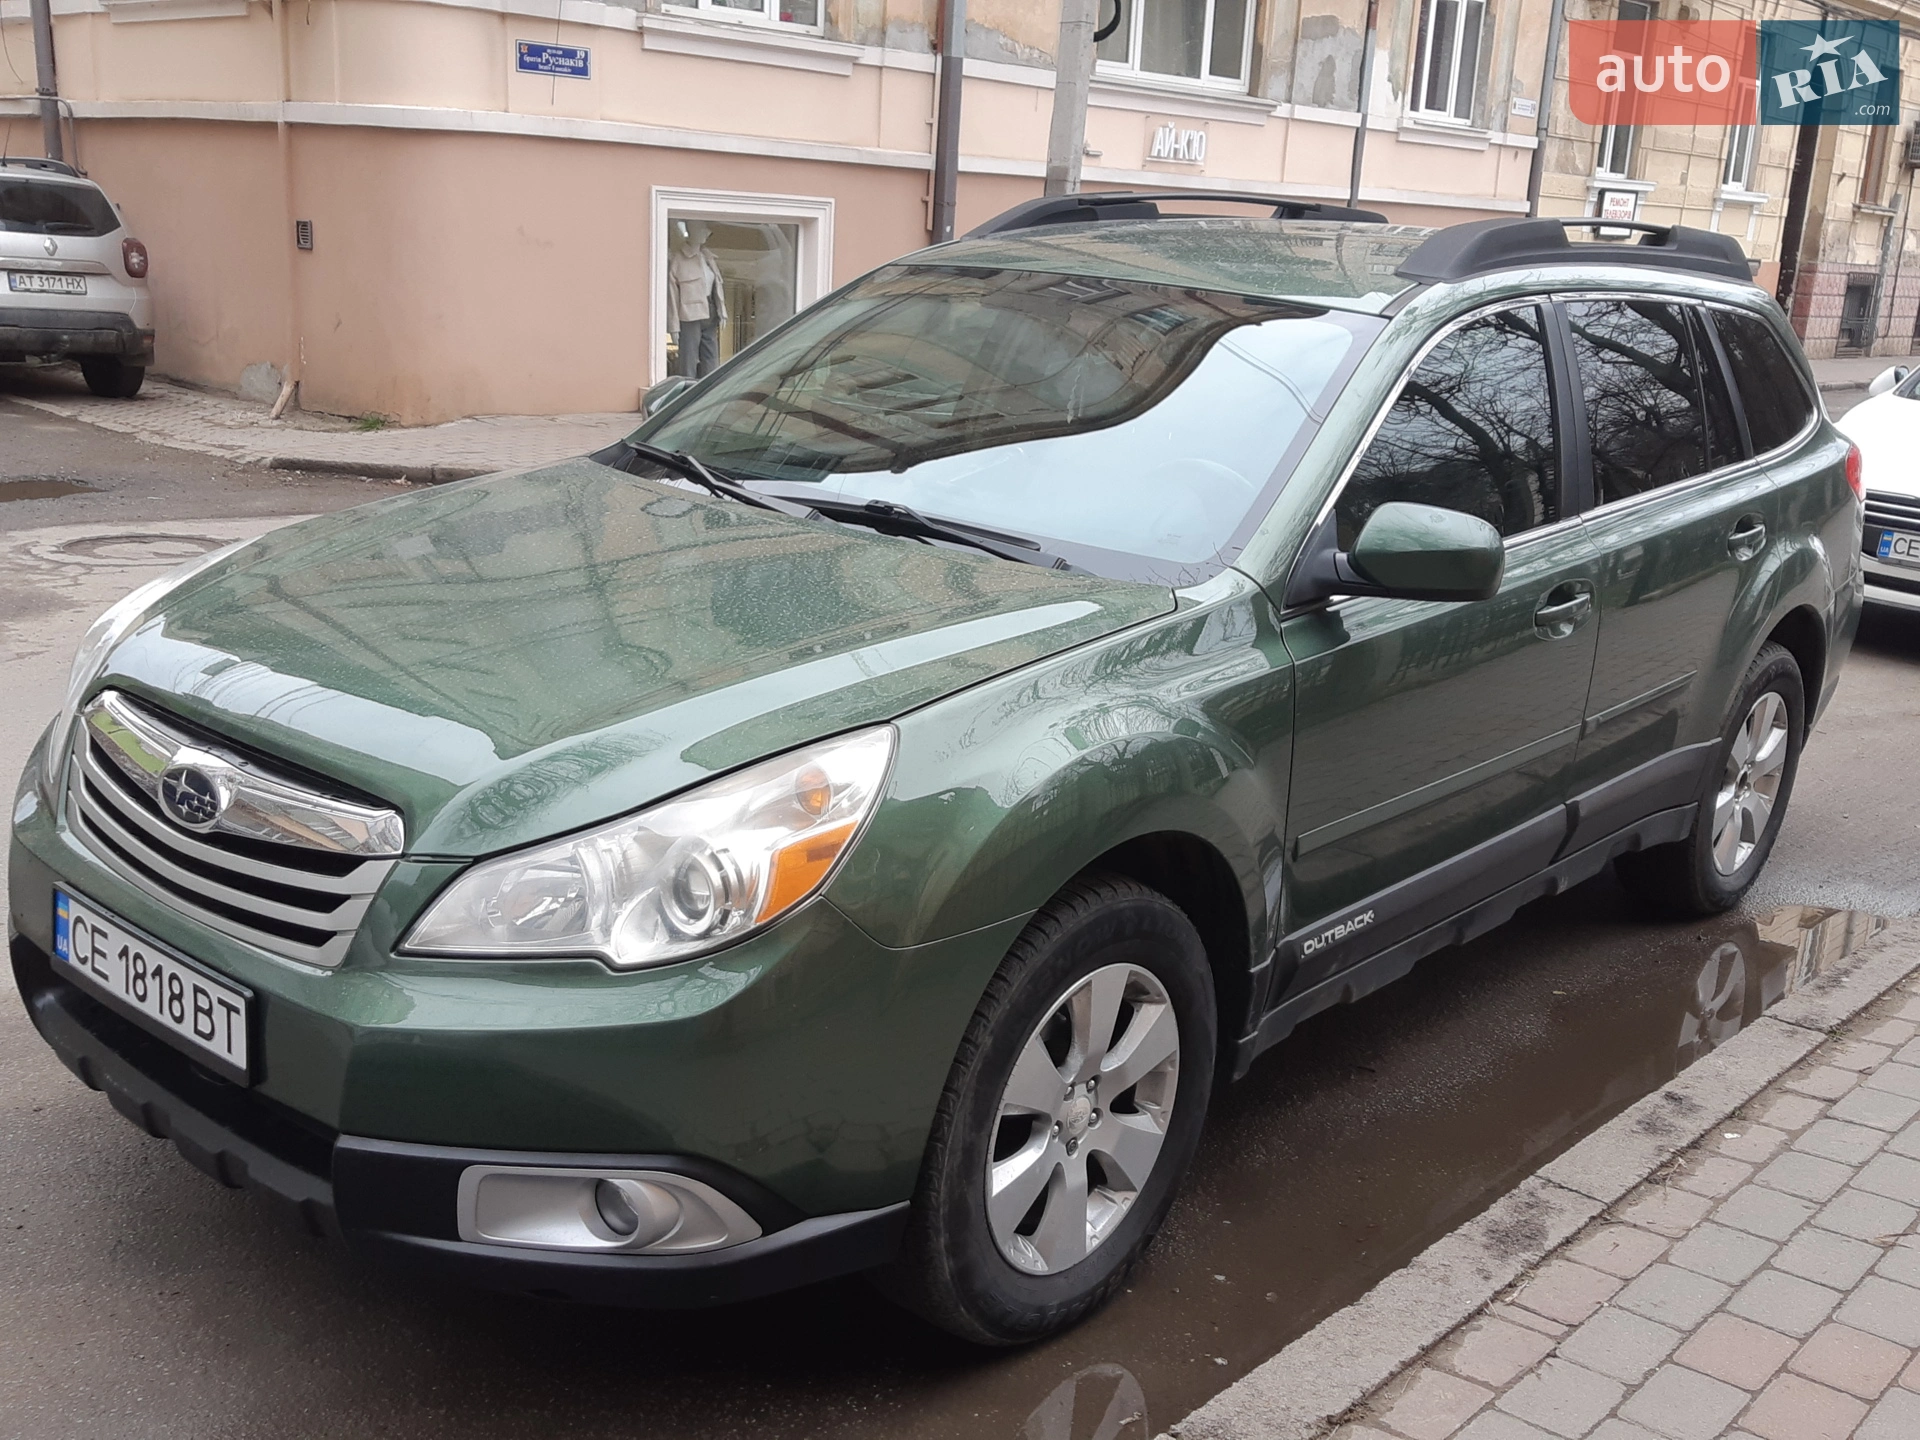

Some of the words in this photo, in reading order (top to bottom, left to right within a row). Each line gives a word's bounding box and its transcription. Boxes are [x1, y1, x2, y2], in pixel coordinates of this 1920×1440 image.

[541, 52, 584, 68] Руснаків
[575, 50, 585, 60] 19
[1609, 197, 1630, 208] РЕМОНТ
[18, 275, 35, 288] AT
[38, 276, 63, 289] 3171
[66, 278, 83, 290] HX
[1303, 910, 1374, 955] OUTBACK
[57, 934, 69, 954] UA
[72, 915, 109, 982] CE
[118, 944, 185, 1024] 1818
[193, 983, 241, 1055] BT
